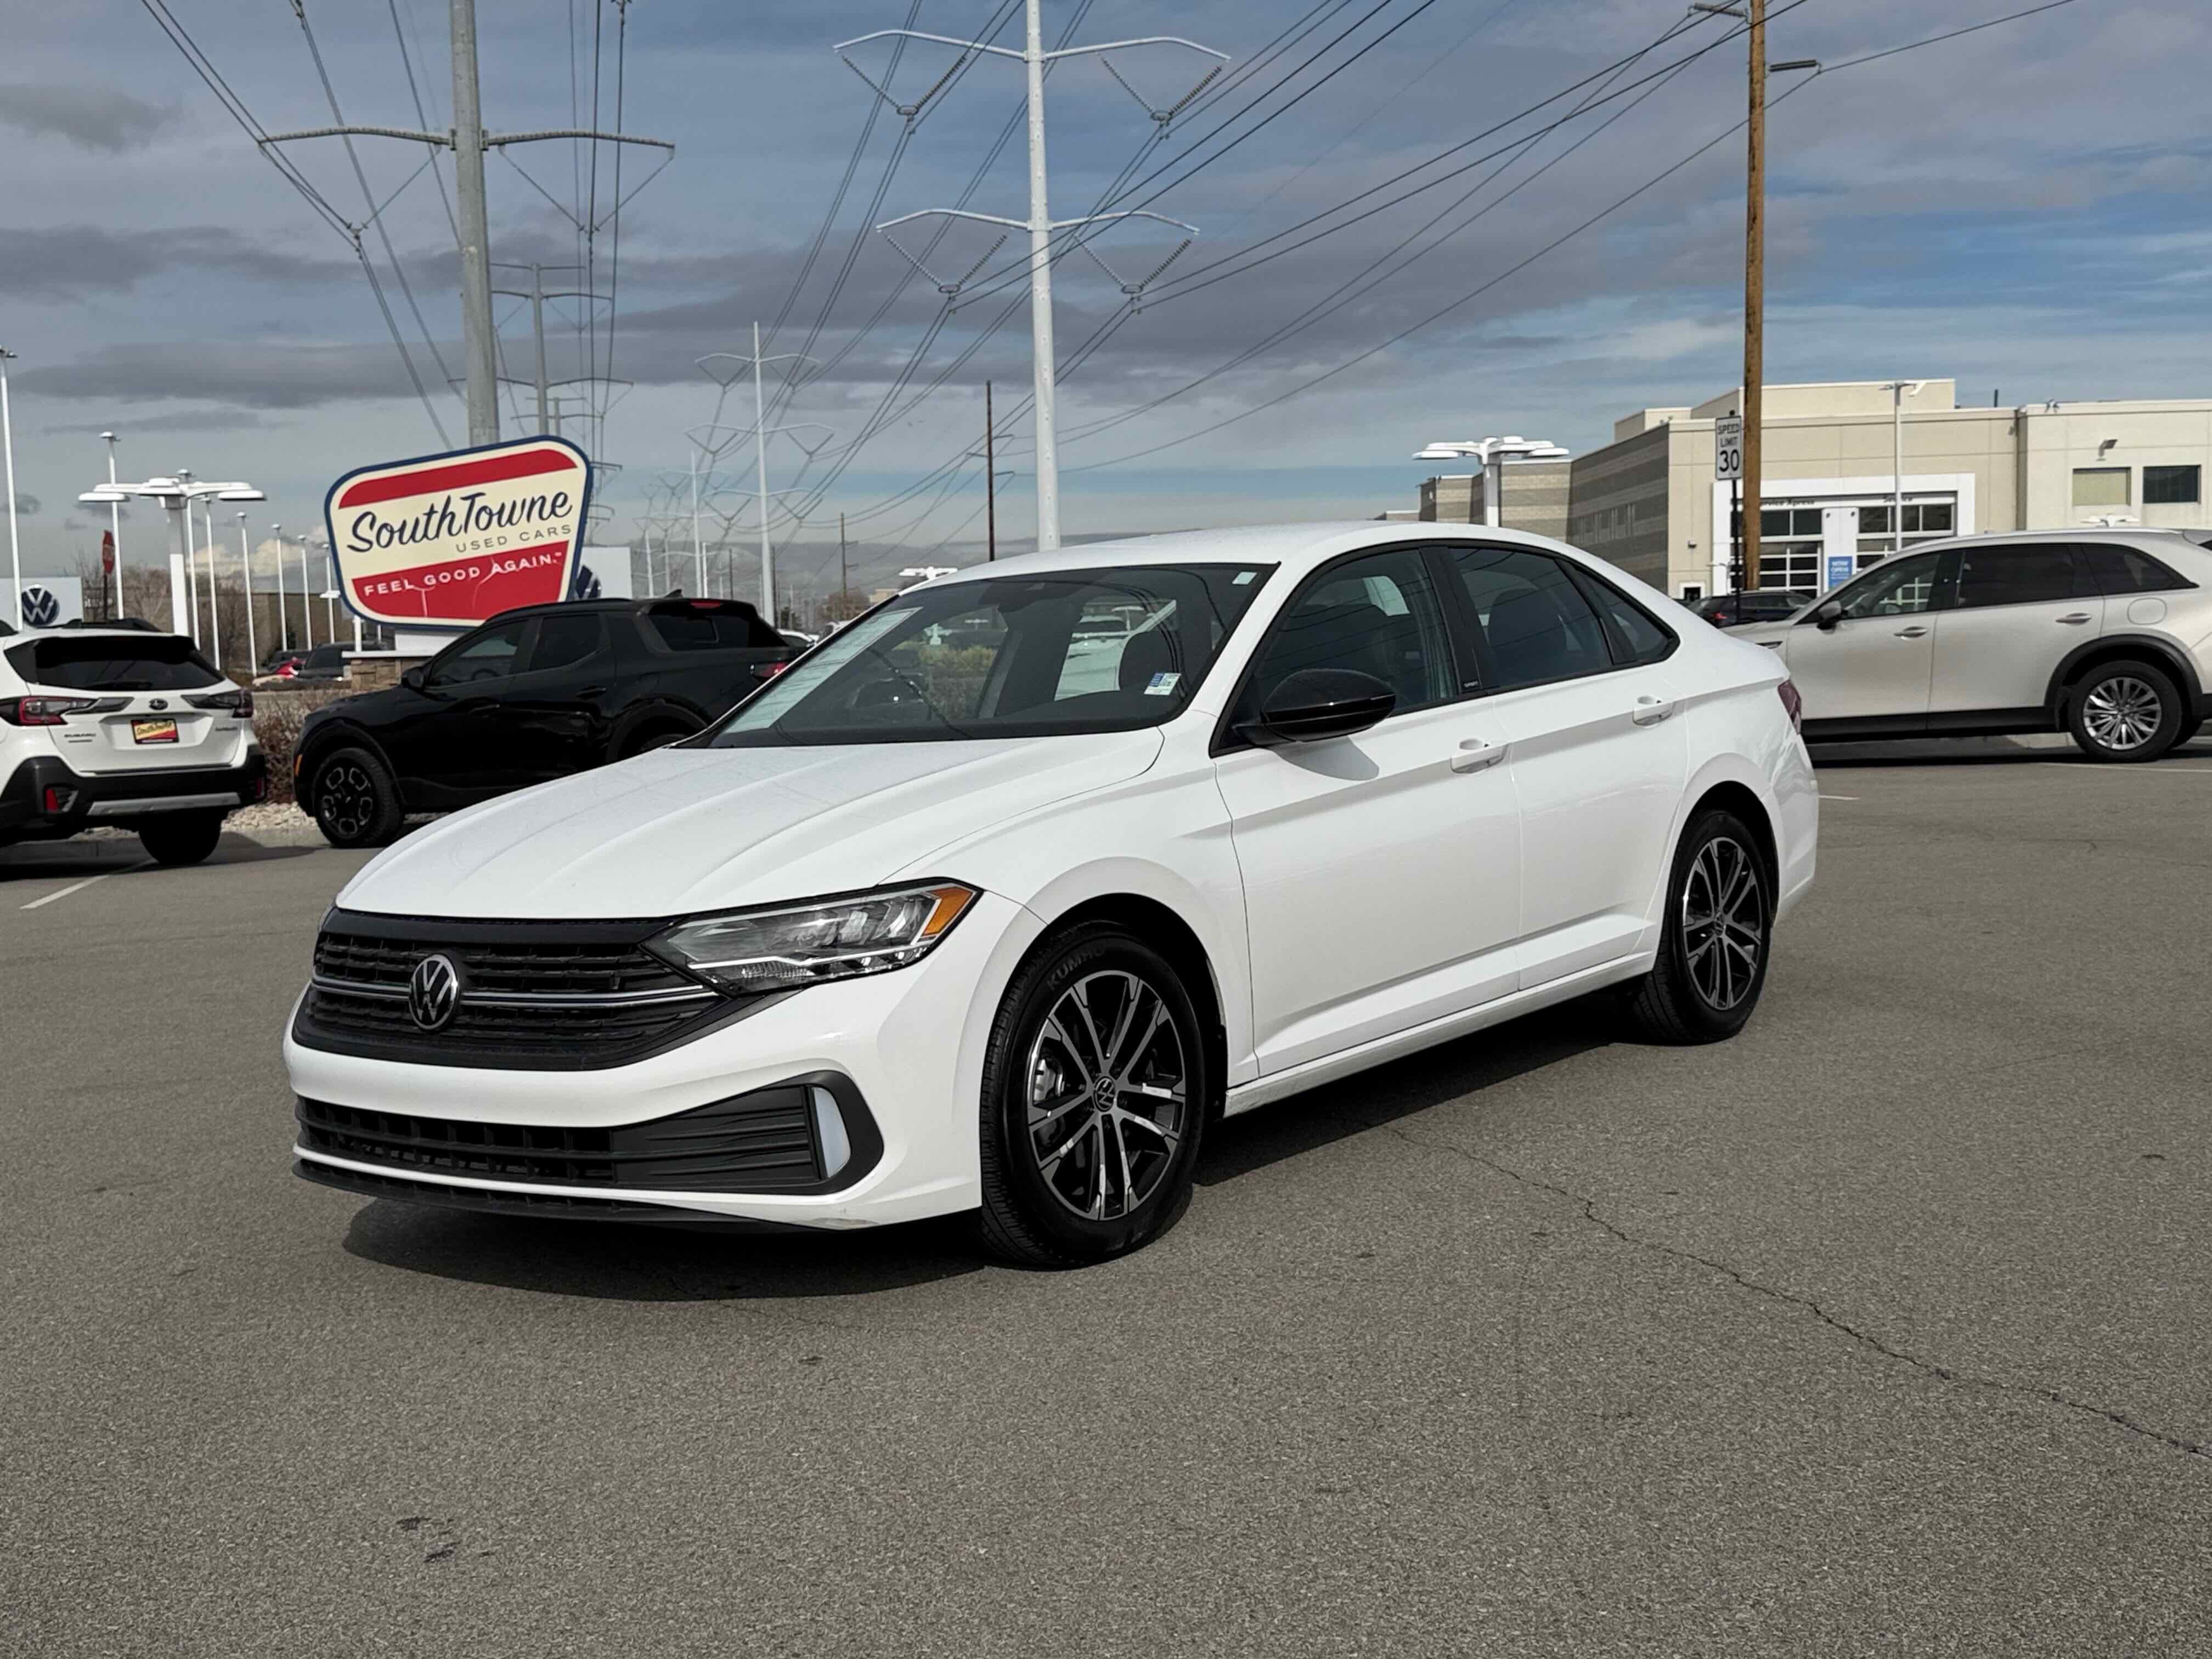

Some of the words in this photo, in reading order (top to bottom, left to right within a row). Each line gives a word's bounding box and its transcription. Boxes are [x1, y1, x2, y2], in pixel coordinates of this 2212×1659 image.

[1718, 423, 1739, 435] SPEED
[1720, 436, 1739, 448] LIMIT
[1719, 449, 1739, 472] 30
[347, 491, 573, 552] SouthTowne
[456, 535, 507, 553] USED
[519, 524, 571, 541] CARS
[364, 579, 414, 596] FEEL
[424, 567, 480, 586] GOOD
